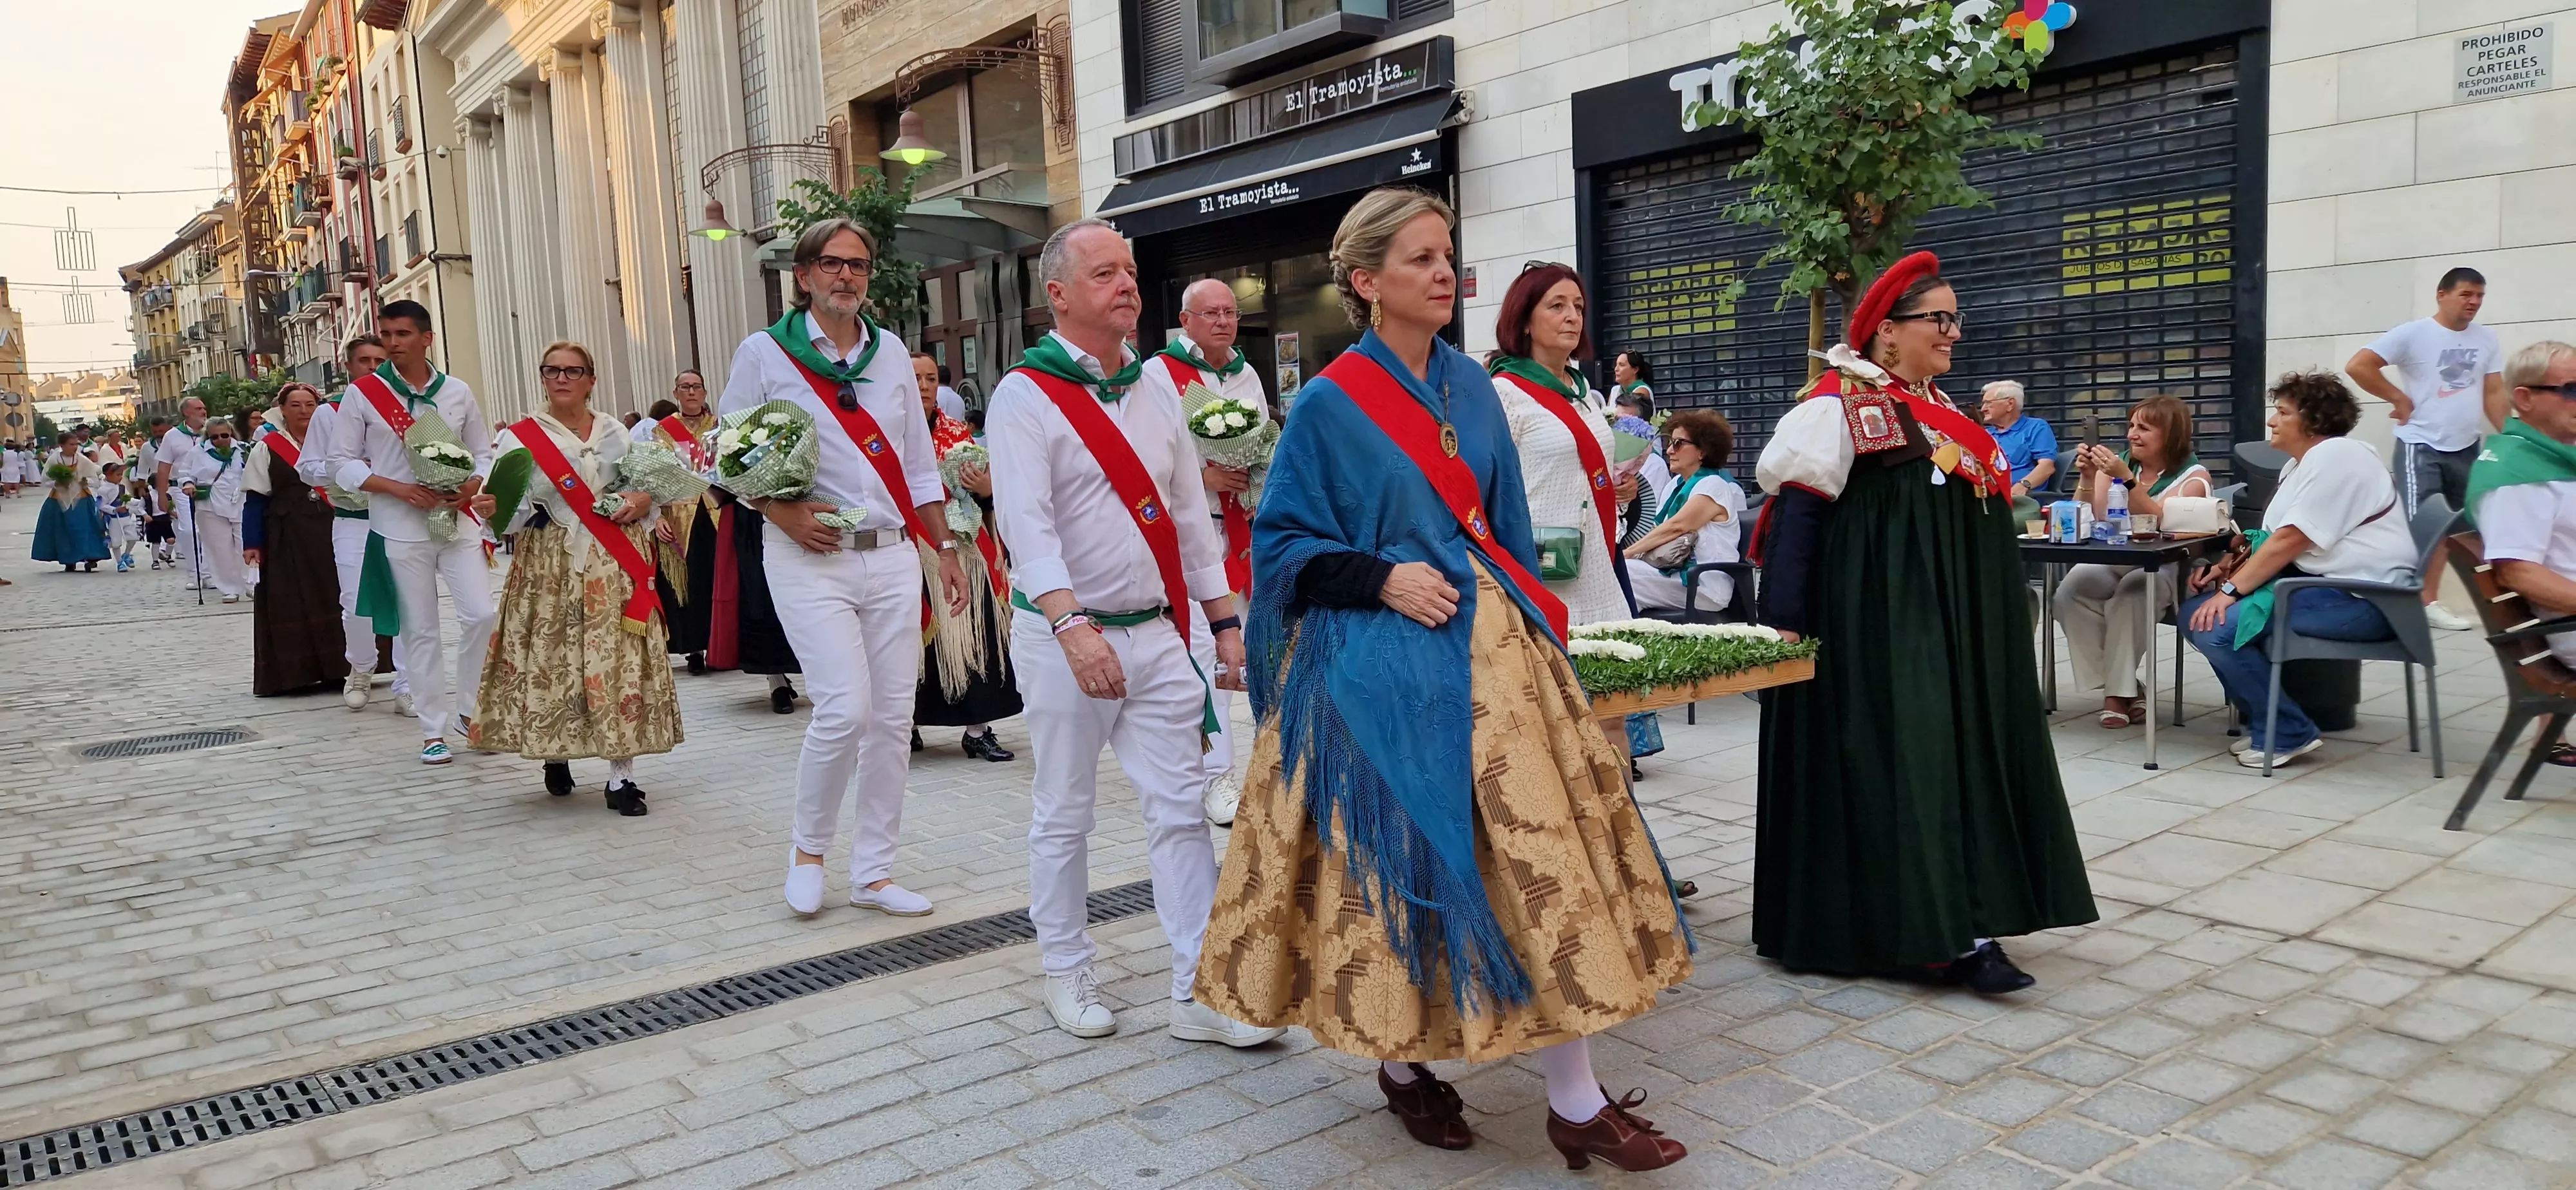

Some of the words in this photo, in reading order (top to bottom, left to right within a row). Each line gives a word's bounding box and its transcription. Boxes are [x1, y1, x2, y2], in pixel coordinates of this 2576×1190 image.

[2462, 27, 2544, 50] PROHIBIDO
[2478, 44, 2526, 61] PEGAR
[2467, 56, 2537, 77] CARTELES
[1285, 91, 1303, 112] El
[1309, 63, 1417, 105] Tramoyista...
[2458, 70, 2531, 89] RESPONSABLE
[2535, 68, 2546, 77] EL
[2467, 79, 2536, 97] ANUNCIANTE
[1401, 158, 1432, 175] Heineken
[1199, 196, 1215, 213] El
[1218, 181, 1300, 210] Tramoyista...
[2070, 261, 2110, 274] JUEOS
[2436, 348, 2479, 368] NIKE
